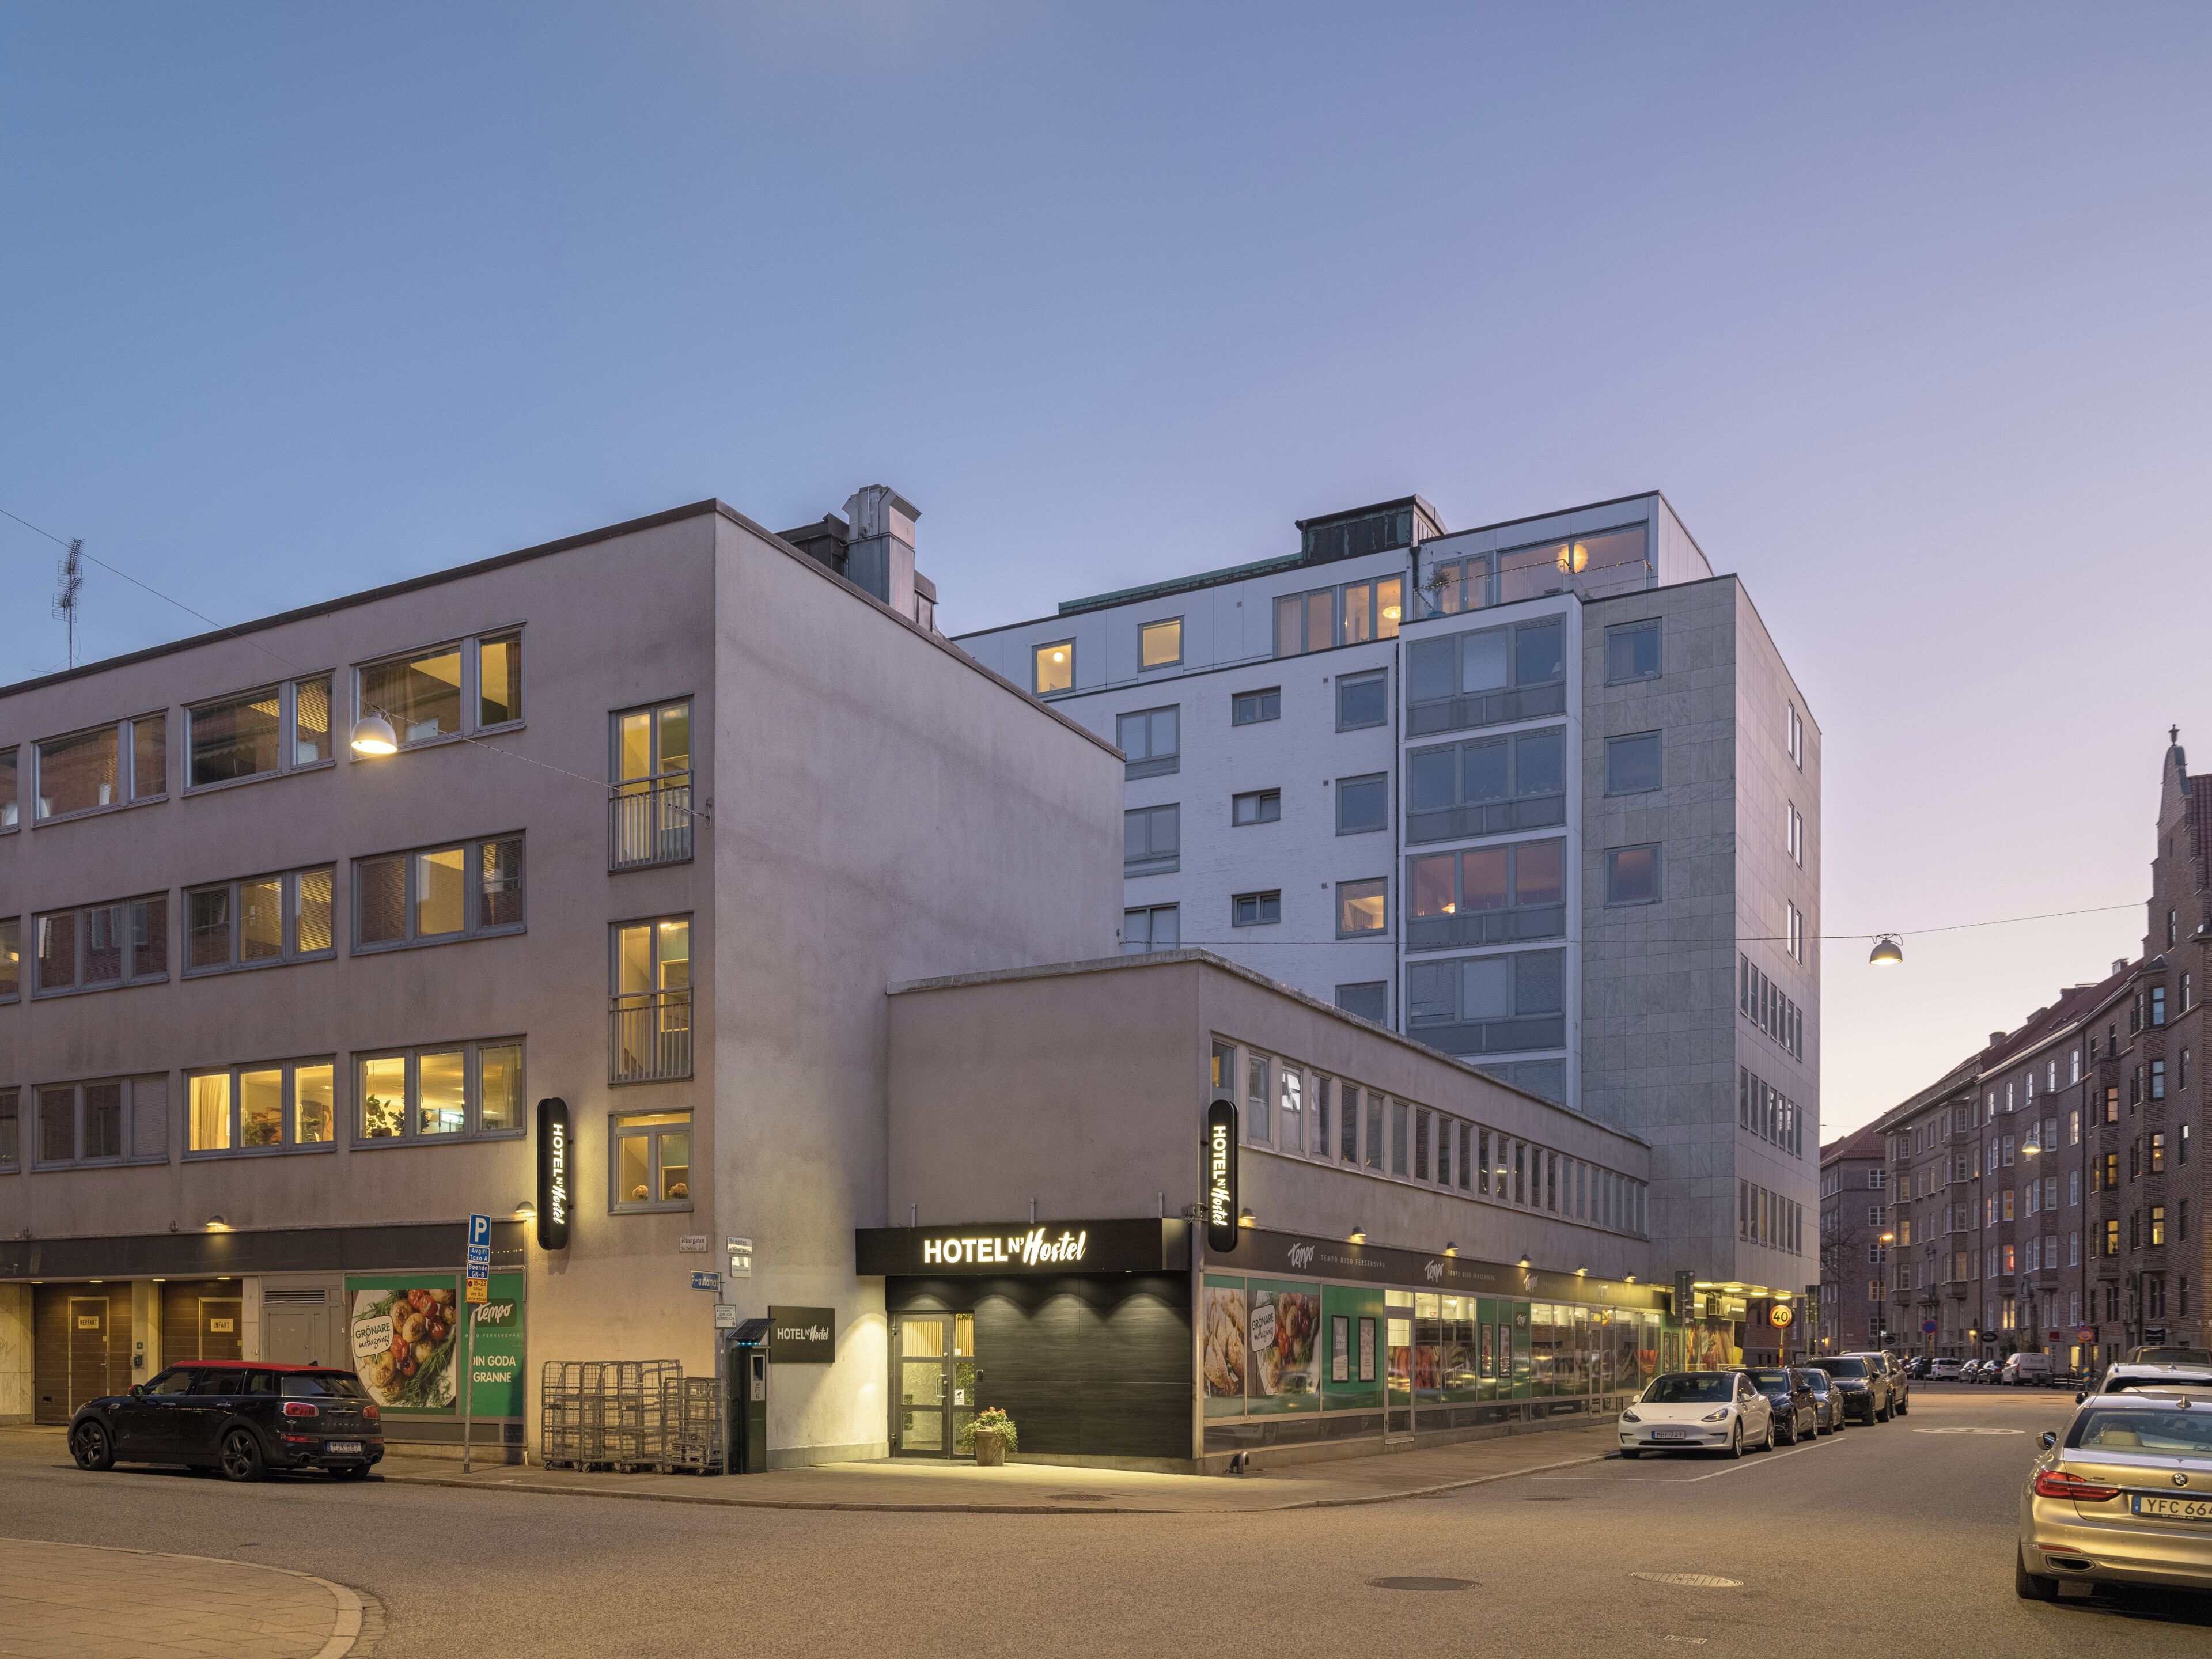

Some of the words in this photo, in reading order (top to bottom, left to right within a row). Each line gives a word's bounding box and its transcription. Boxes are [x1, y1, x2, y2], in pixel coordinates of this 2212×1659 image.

[553, 1124, 563, 1177] HOTEL
[1213, 1126, 1226, 1179] HOTEL
[551, 1185, 566, 1225] Hostel
[1211, 1188, 1230, 1226] Hostel
[475, 1217, 487, 1243] P
[924, 1238, 1008, 1263] HOTEL
[1022, 1227, 1086, 1266] Hostel
[1321, 1255, 1338, 1263] TEMPO
[691, 1275, 719, 1287] P-automat
[1252, 1313, 1274, 1330] GRÖNARE
[1773, 1312, 1788, 1322] 40
[355, 1323, 391, 1339] GRÖNARE
[777, 1328, 805, 1340] HOTEL
[809, 1324, 829, 1342] Hostel
[487, 1355, 516, 1366] GODA
[473, 1372, 512, 1382] GRANNE
[2147, 1499, 2179, 1513] YFC
